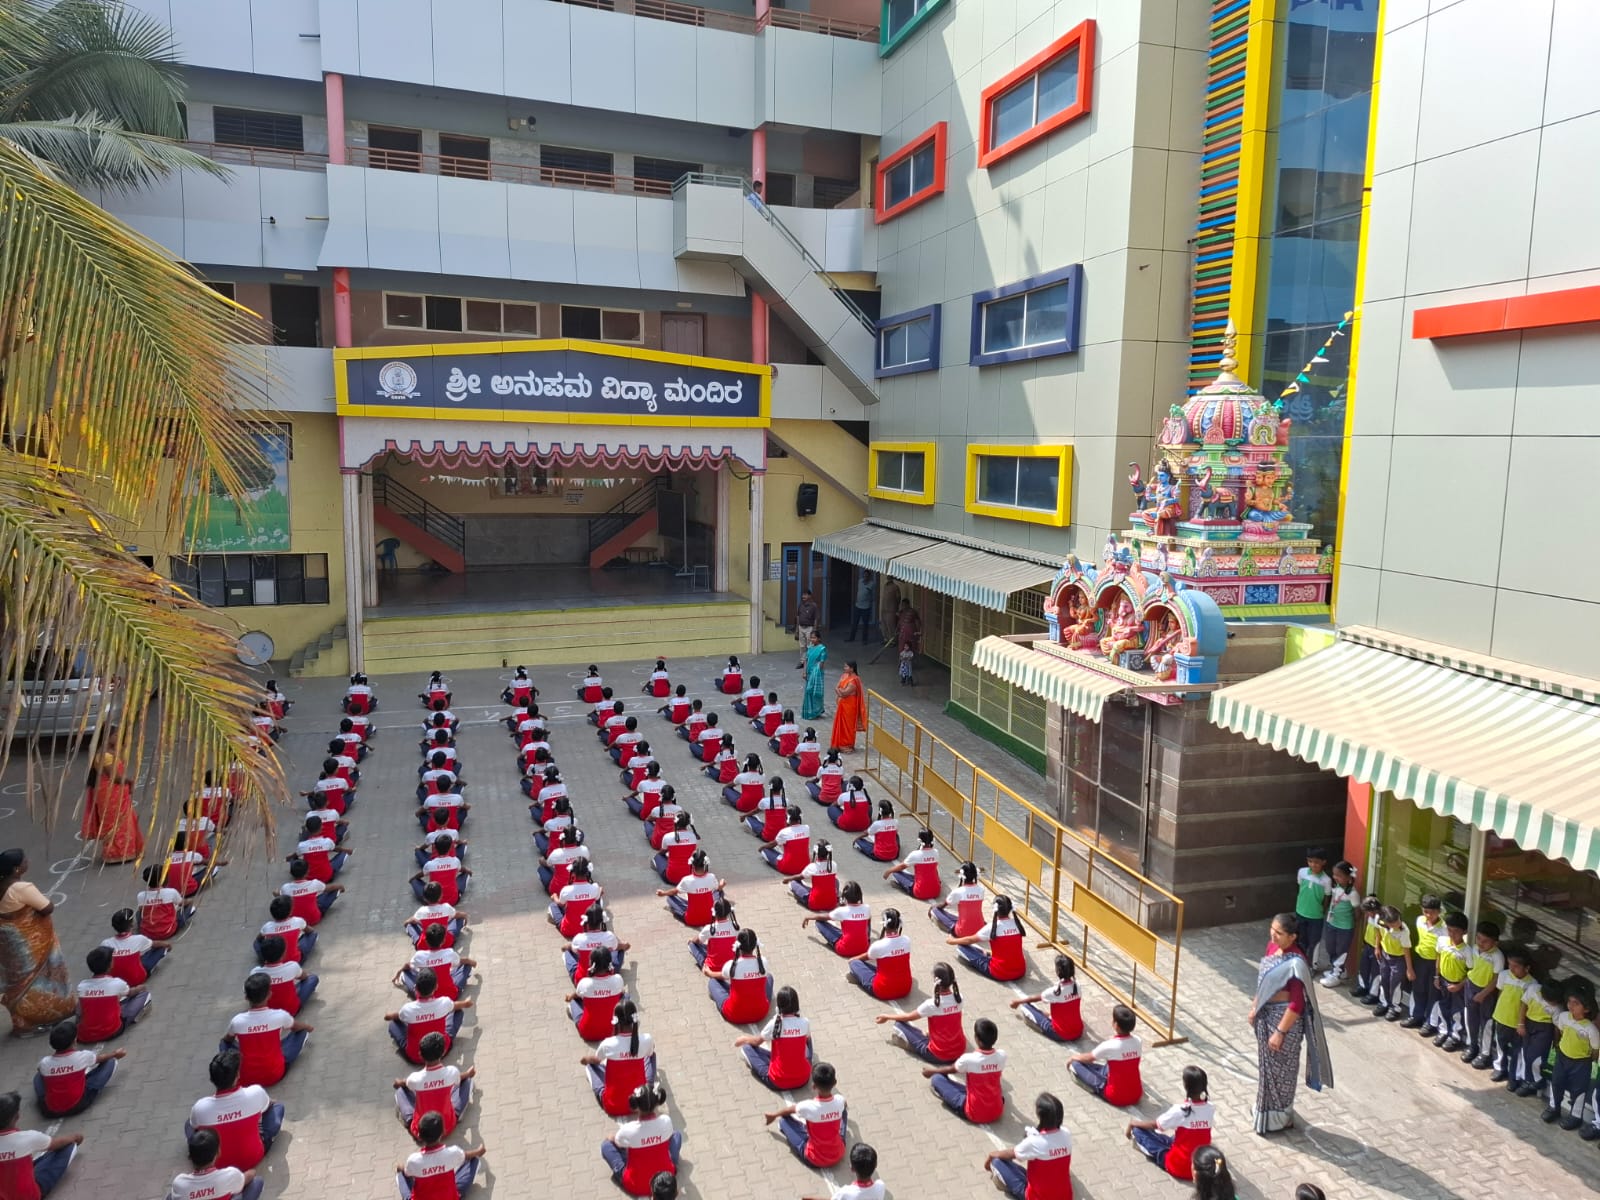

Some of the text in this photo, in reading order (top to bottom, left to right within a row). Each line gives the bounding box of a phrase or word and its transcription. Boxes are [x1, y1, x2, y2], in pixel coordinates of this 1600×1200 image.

[445, 367, 482, 402] ಶ್ರೀ
[490, 369, 593, 399] ಅನುಪಮ
[601, 376, 658, 413] ವಿದ್ಯಾ
[664, 376, 743, 404] ಮಂದಿರ
[248, 1024, 268, 1032] SAVM
[51, 1066, 73, 1074] SAVM
[424, 1080, 444, 1088] SAVM
[217, 1111, 241, 1121] SAVM
[821, 1112, 839, 1120] SAVM
[641, 1136, 661, 1144] SAVM
[423, 1165, 445, 1174] SAVM
[190, 1188, 214, 1199] SAVM
